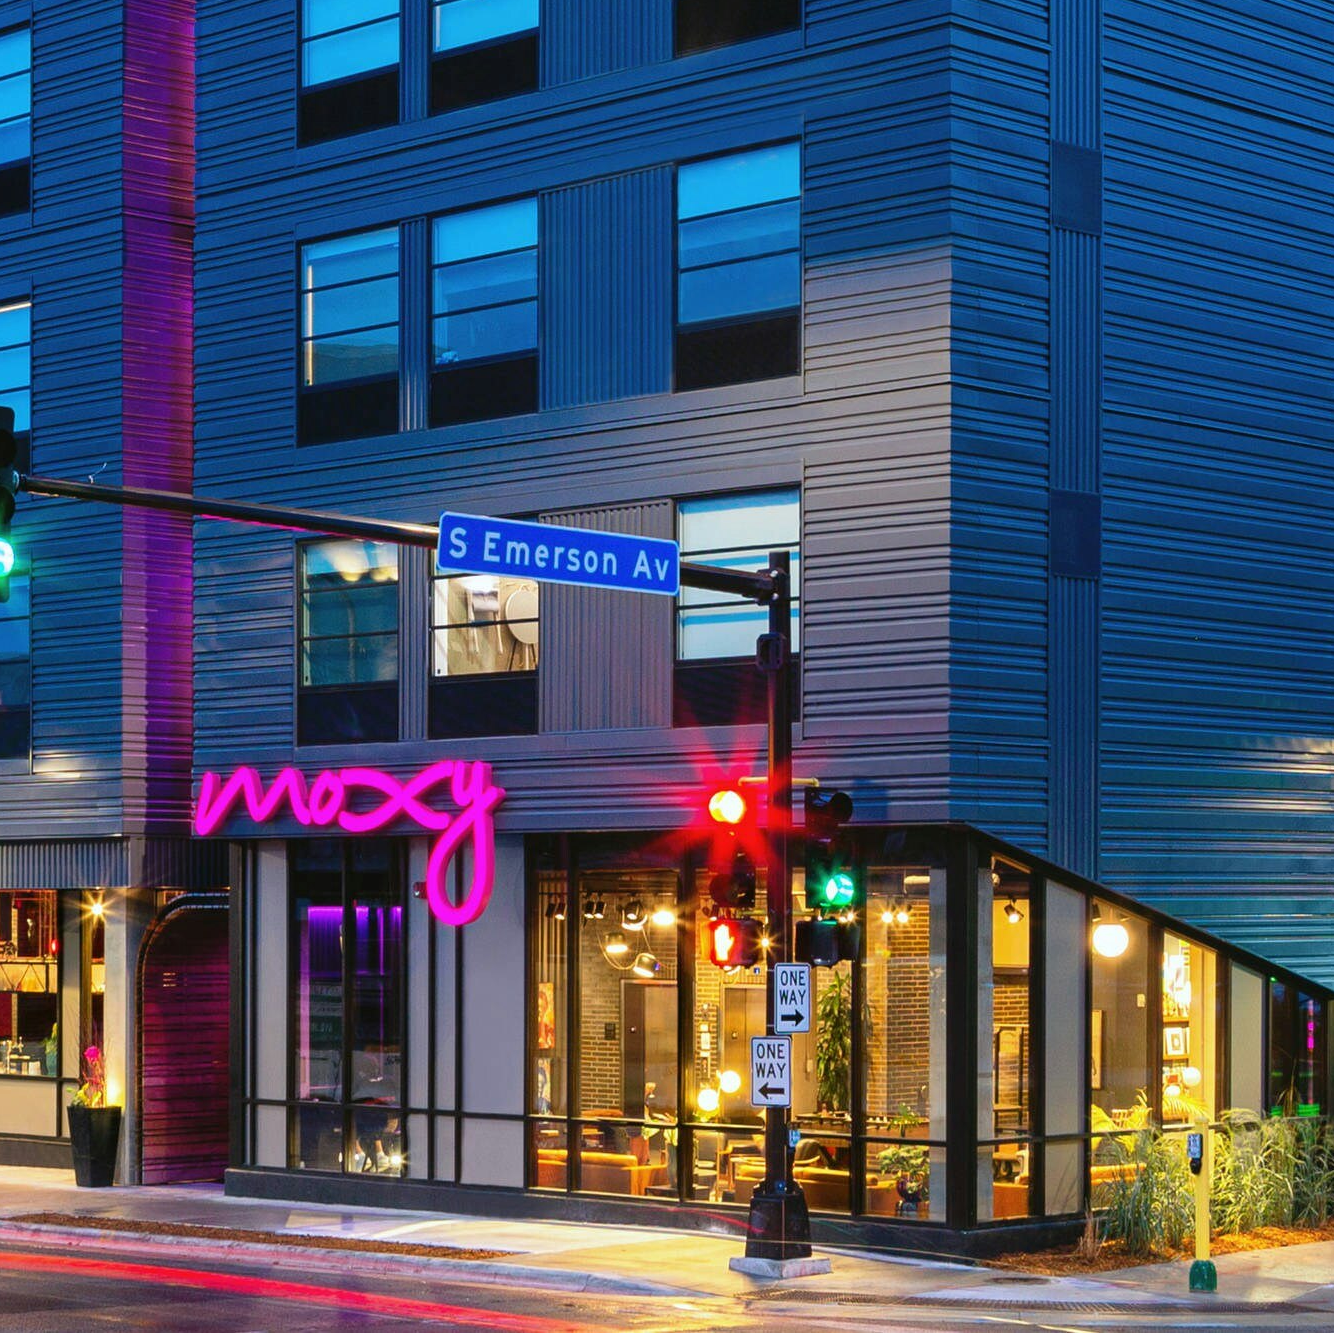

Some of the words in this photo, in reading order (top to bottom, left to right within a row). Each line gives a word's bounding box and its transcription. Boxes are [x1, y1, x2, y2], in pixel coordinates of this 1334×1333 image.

[449, 526, 467, 559] S
[483, 530, 617, 576] Emerson
[632, 549, 670, 581] Av
[192, 759, 505, 926] moxy
[780, 970, 806, 986] ONE
[779, 989, 806, 1005] WAY
[756, 1043, 785, 1059] ONE
[755, 1062, 786, 1078] WAY
